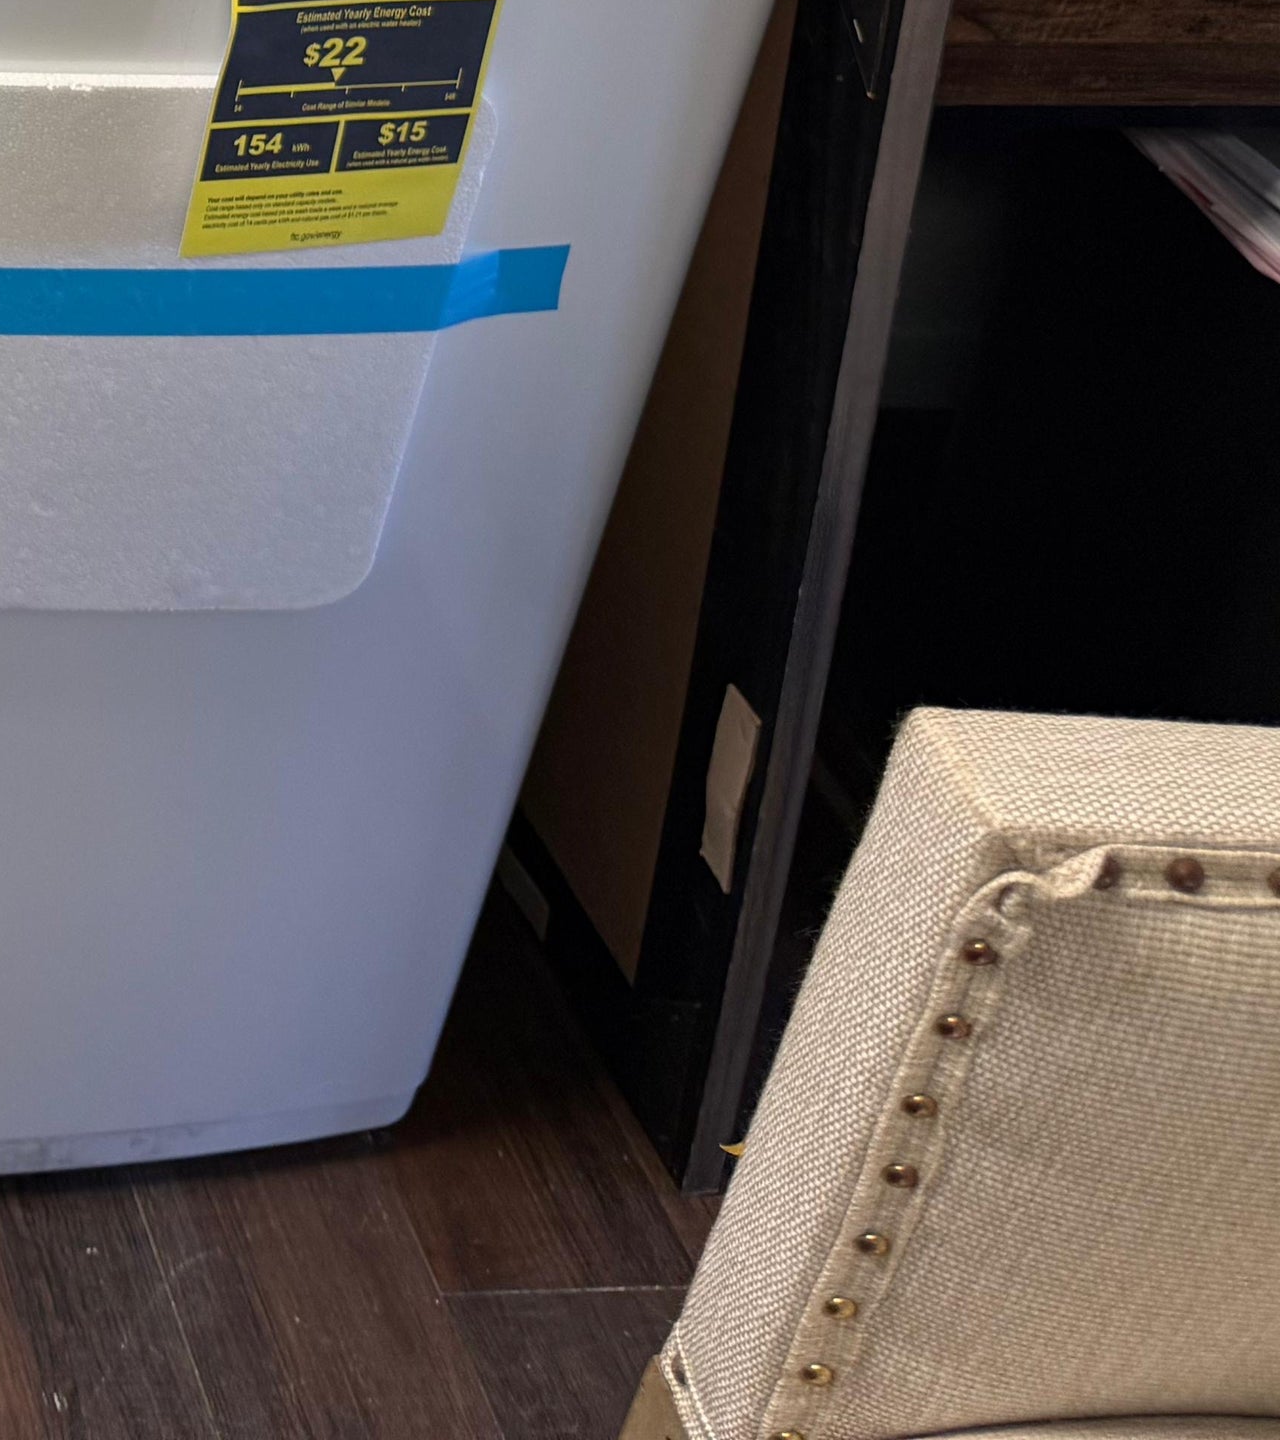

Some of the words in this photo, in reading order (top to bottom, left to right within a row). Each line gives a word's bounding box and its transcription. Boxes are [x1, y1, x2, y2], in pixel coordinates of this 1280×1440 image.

[296, 11, 341, 23] Estimated
[344, 7, 372, 20] Yearly
[374, 6, 407, 19] Energy
[409, 5, 432, 17] Cost
[303, 36, 368, 67] $22
[377, 120, 429, 146] $15
[233, 132, 283, 156] 154
[292, 142, 310, 153] kWh
[353, 149, 386, 159] Estimated
[386, 148, 406, 159] Yearly
[407, 146, 430, 157] Energy
[431, 145, 447, 155] Cost
[215, 162, 249, 173] Estimated
[250, 161, 271, 172] Yearly
[272, 159, 305, 171] Electricity
[306, 159, 320, 167] Use
